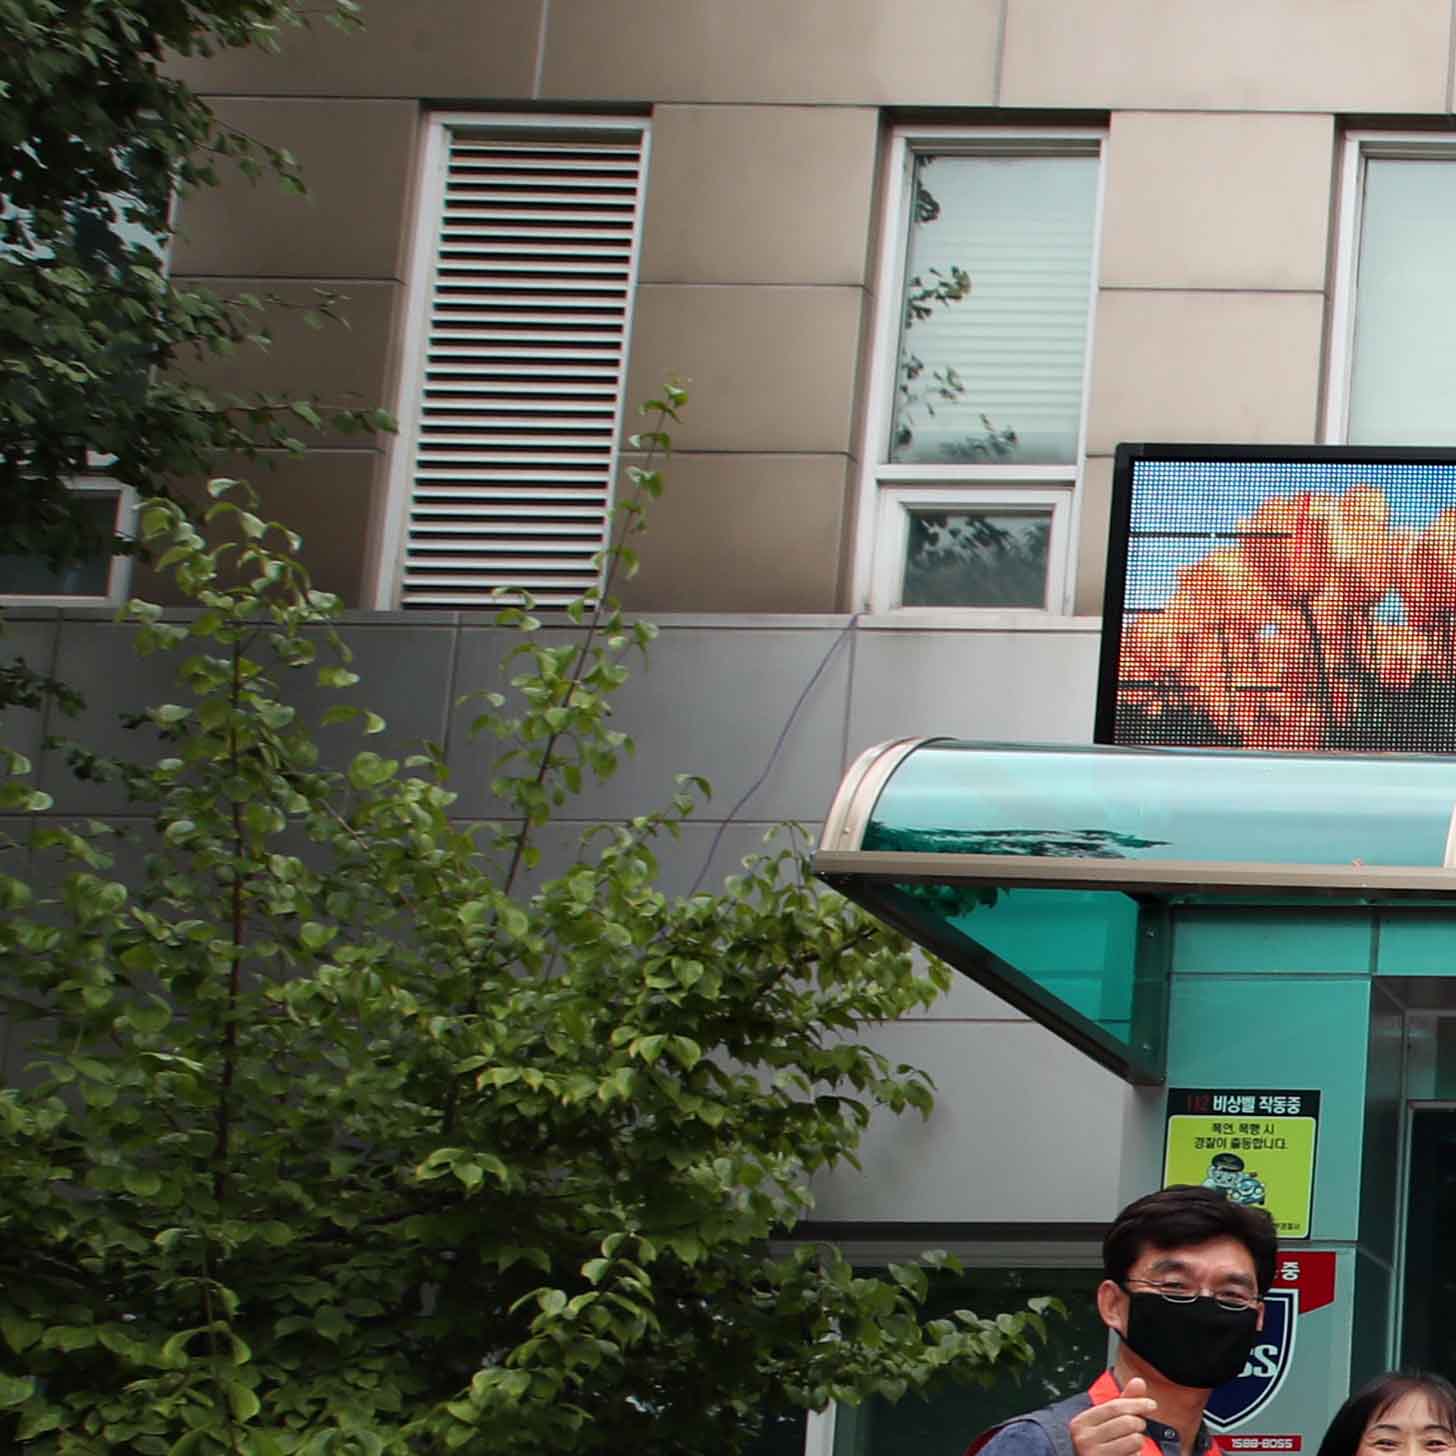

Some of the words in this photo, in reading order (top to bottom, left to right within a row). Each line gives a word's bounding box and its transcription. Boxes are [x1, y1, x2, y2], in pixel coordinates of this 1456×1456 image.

[1213, 1095, 1256, 1113] 비상벨
[1259, 1096, 1301, 1115] 작동중
[1264, 1122, 1275, 1135] 시
